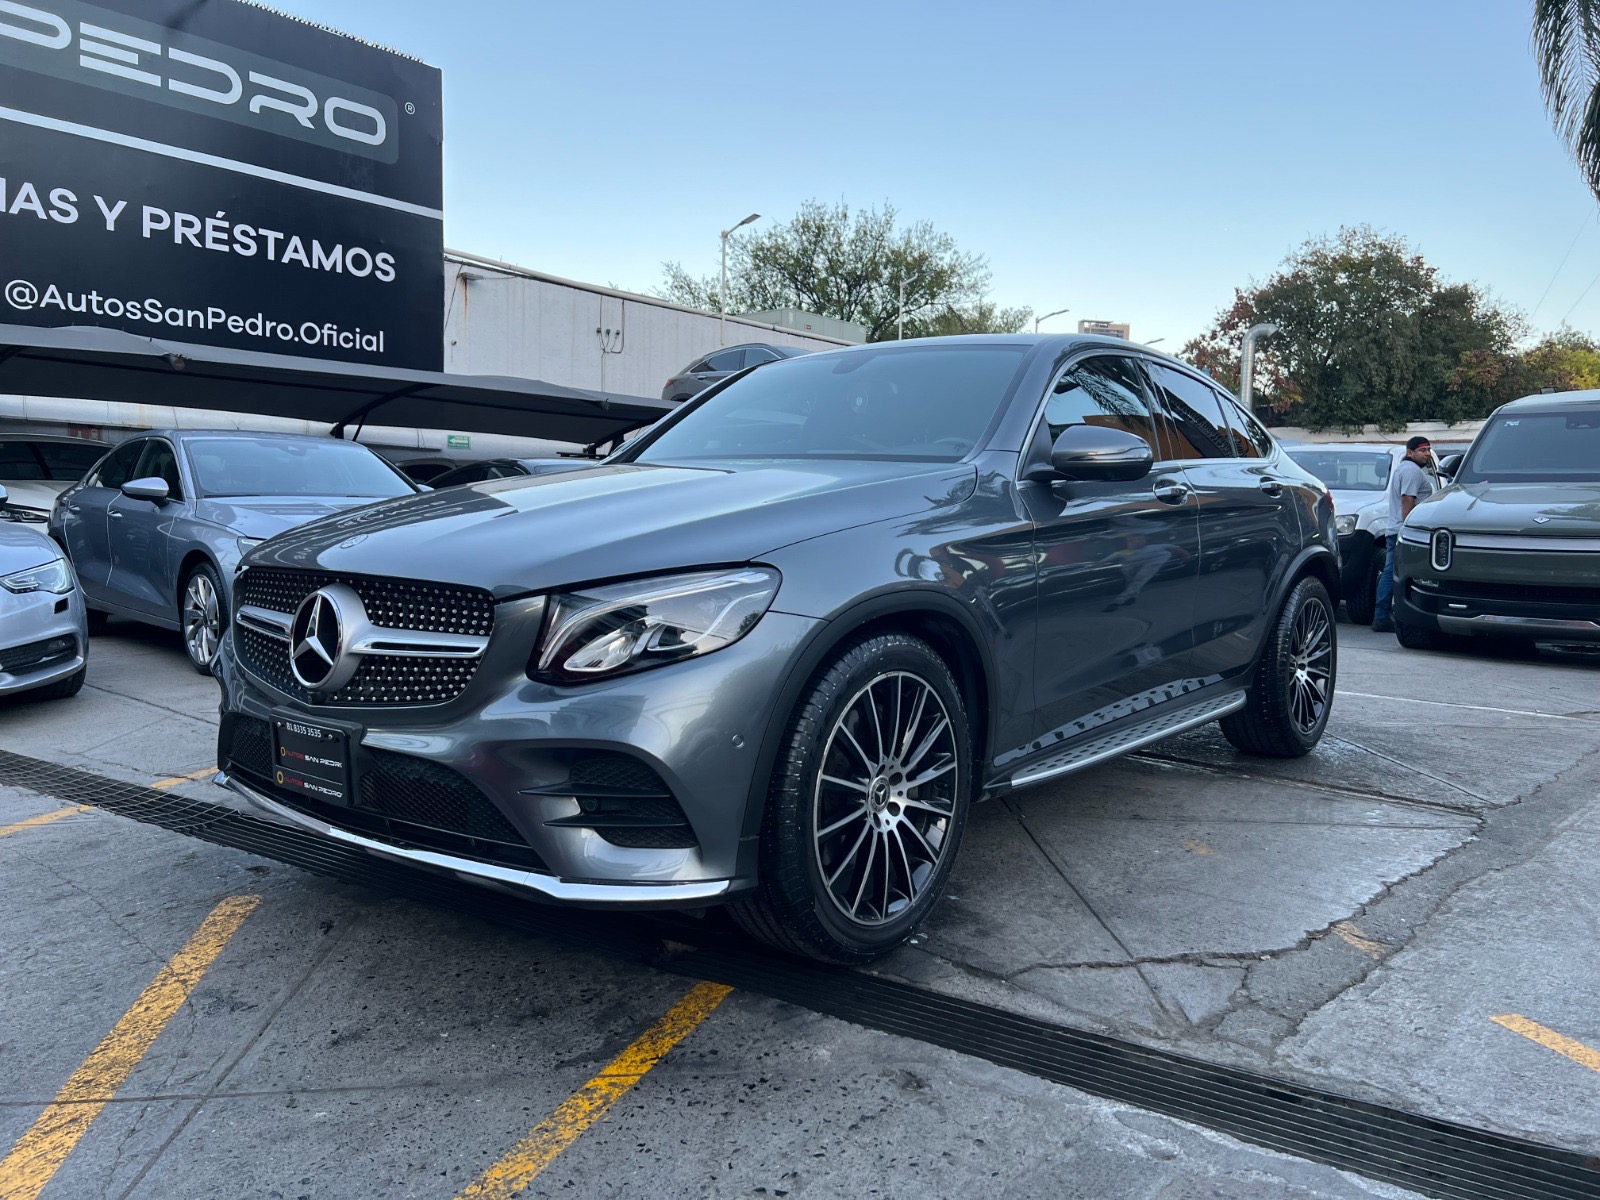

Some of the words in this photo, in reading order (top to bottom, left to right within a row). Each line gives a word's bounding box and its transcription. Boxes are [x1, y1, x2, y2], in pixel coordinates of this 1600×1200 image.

[0, 0, 387, 146] PEDRO
[93, 195, 128, 231] Y
[142, 205, 396, 282] PRÉSTAMOS
[5, 279, 385, 353] @AutosSanPedro.Oficial
[286, 722, 293, 731] 81
[293, 723, 307, 735] 8335
[307, 727, 322, 738] 3535
[305, 754, 319, 763] SAN
[304, 782, 318, 791] SAN
[318, 786, 343, 798] PEDRO
